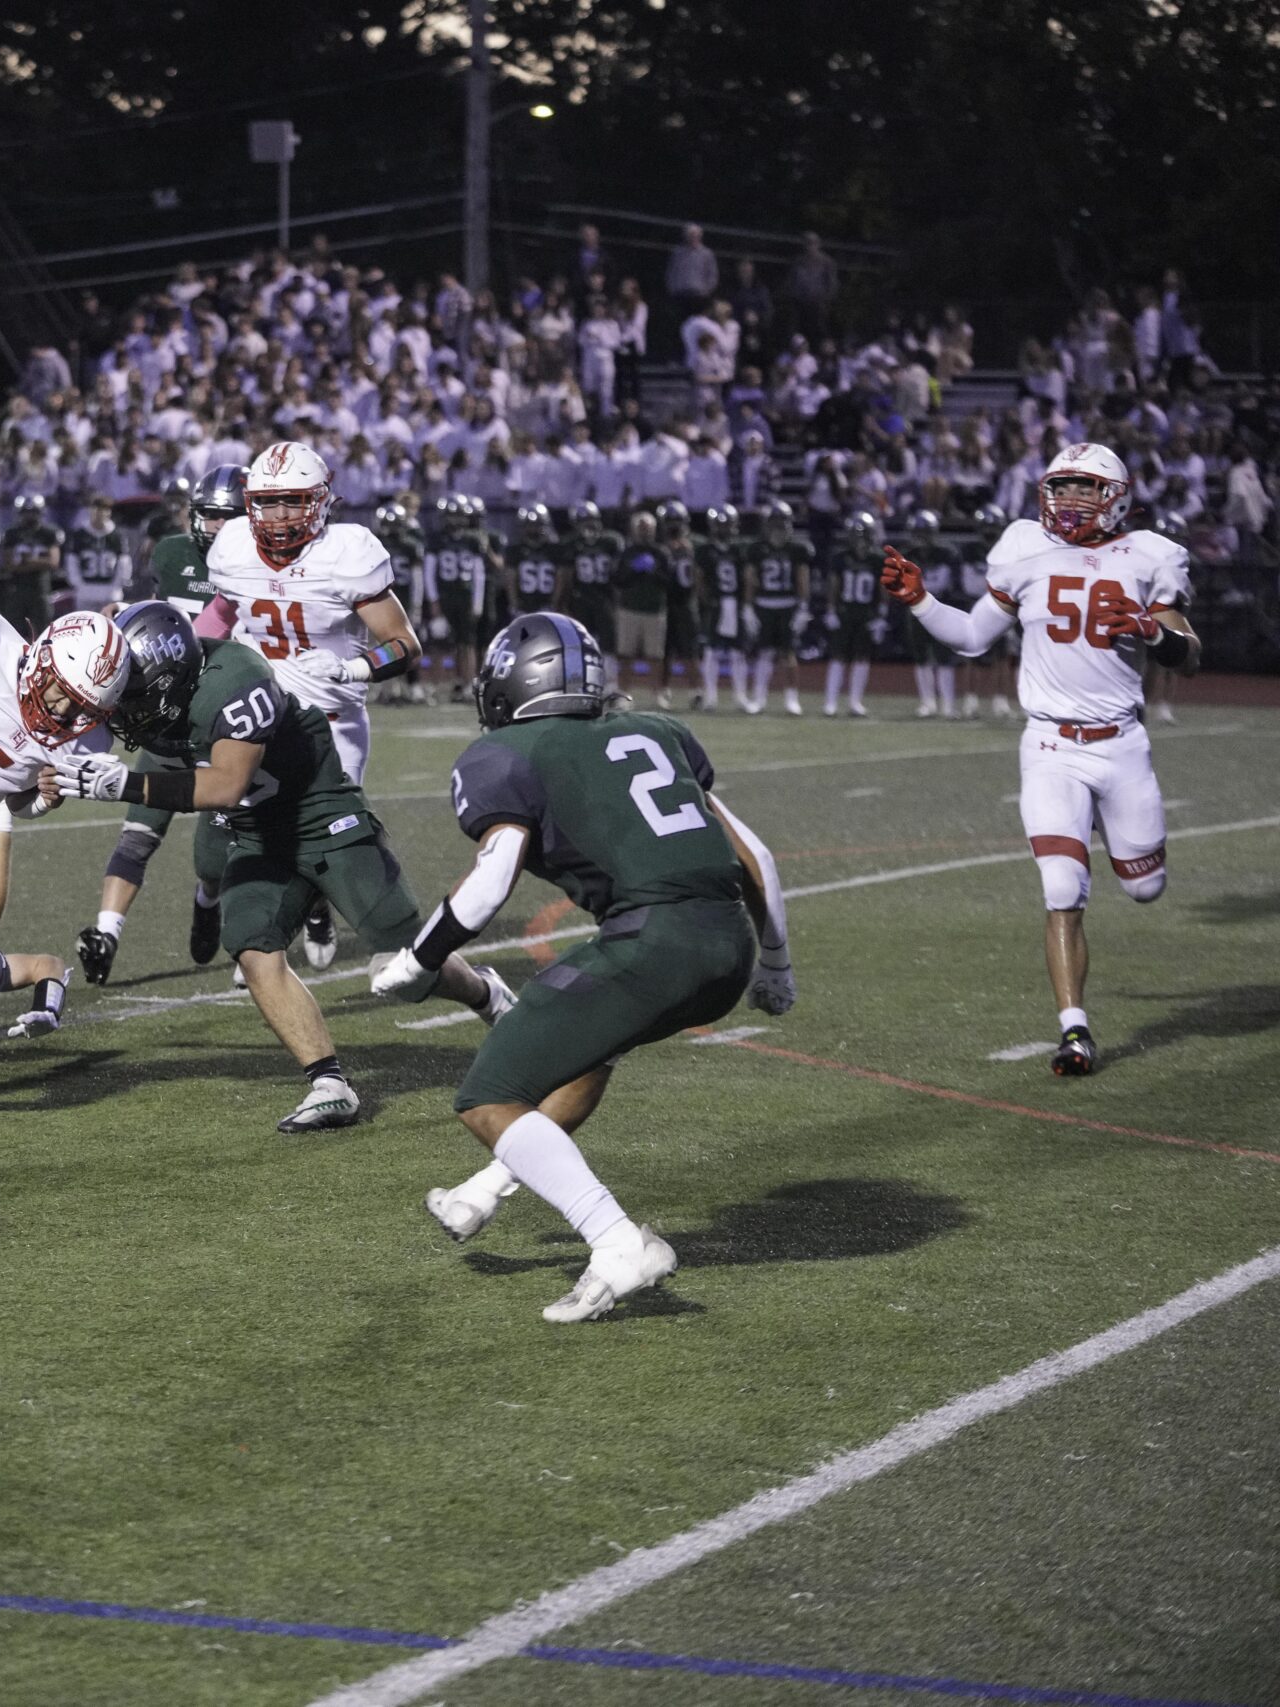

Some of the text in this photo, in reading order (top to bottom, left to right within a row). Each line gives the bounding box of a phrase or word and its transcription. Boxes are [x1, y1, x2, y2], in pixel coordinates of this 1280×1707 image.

[250, 598, 313, 660] 31
[76, 683, 100, 702] Riddell
[222, 686, 275, 740] 50
[605, 733, 707, 838] 2
